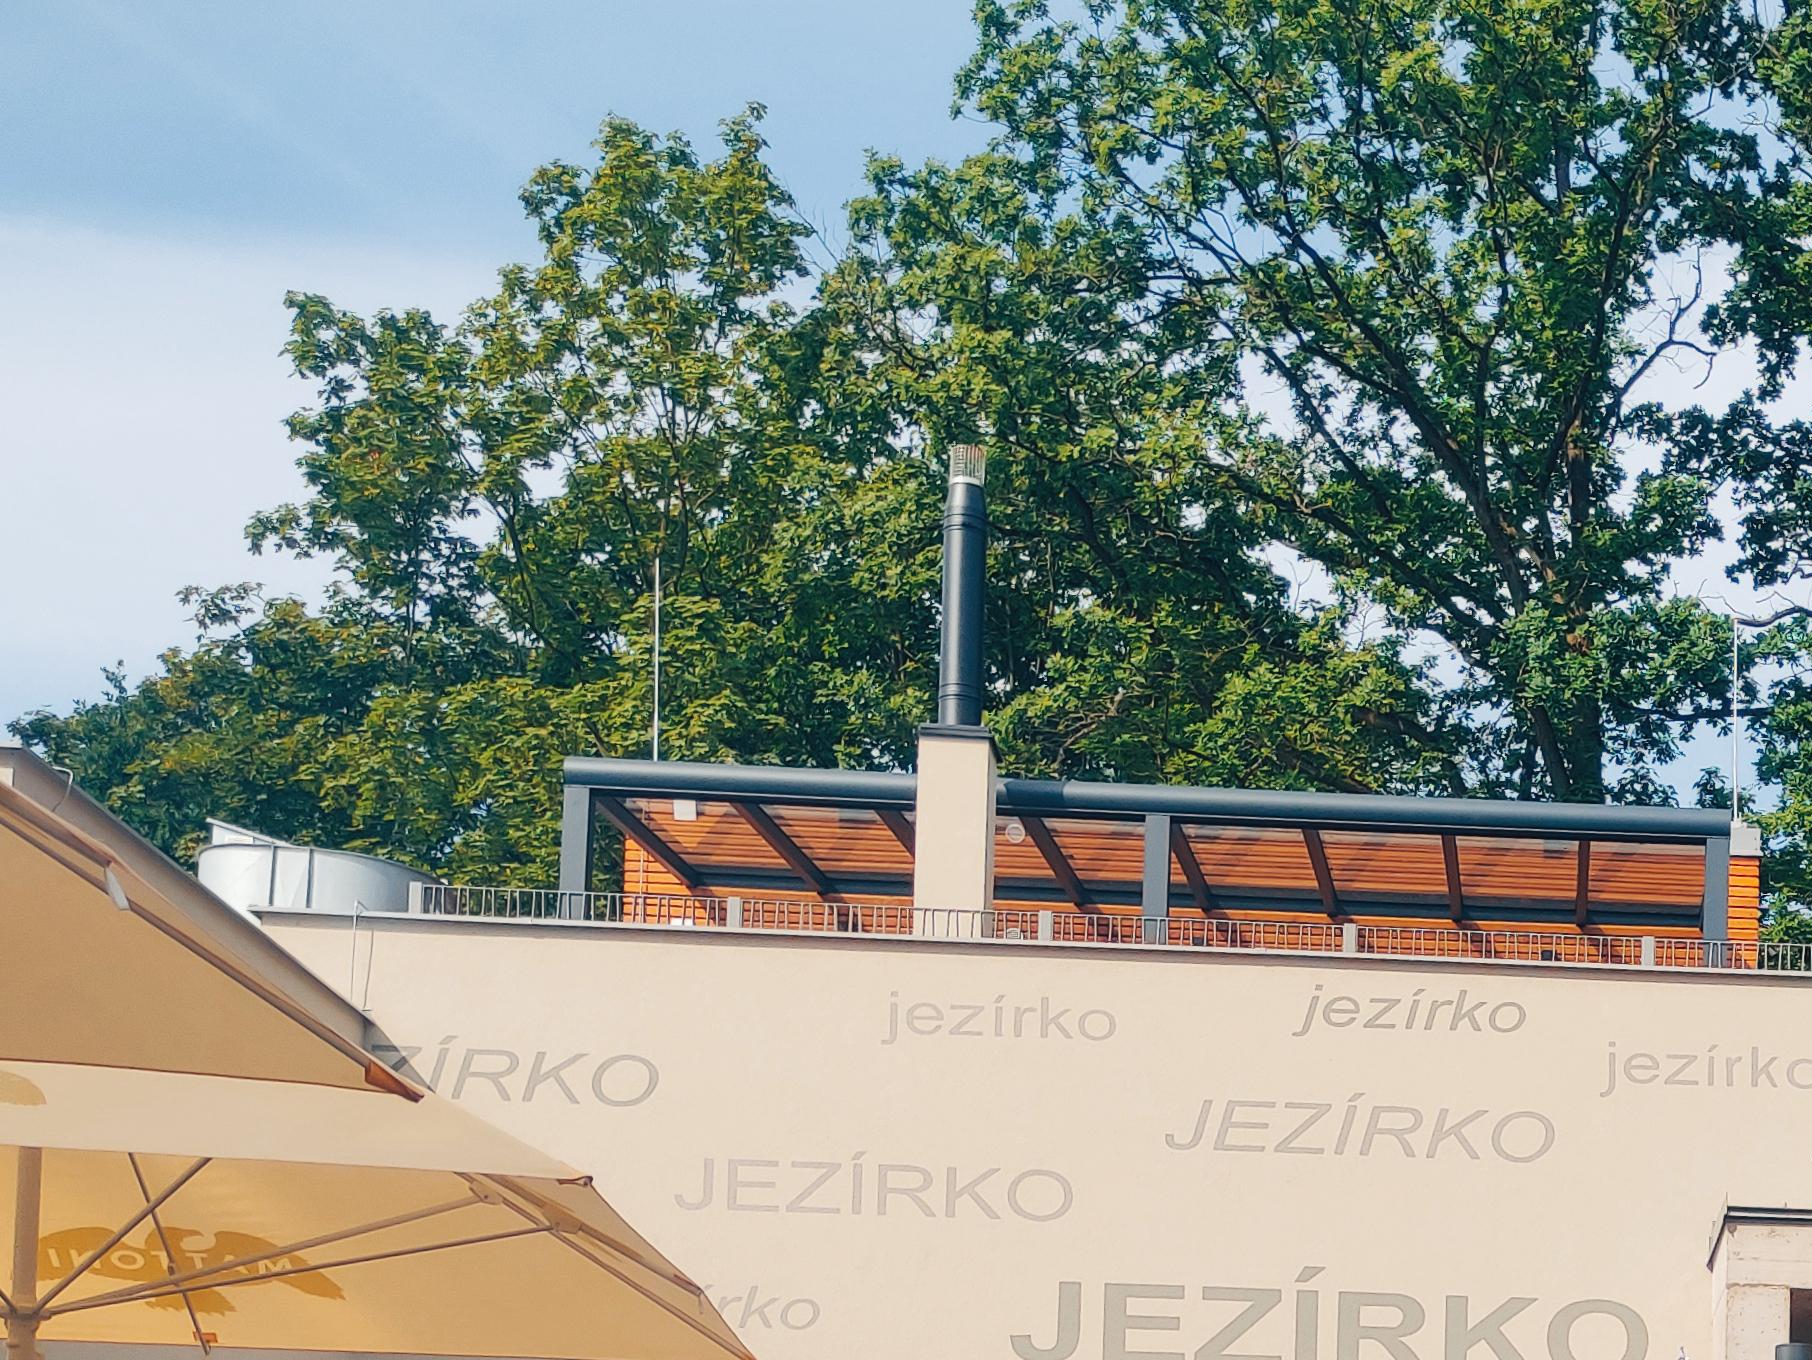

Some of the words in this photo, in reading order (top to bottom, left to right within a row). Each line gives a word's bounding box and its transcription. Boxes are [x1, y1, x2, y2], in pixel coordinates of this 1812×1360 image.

[881, 991, 1118, 1045] jezírko
[1292, 985, 1528, 1037] jezírko
[1164, 1092, 1556, 1164] JEZÍRKO
[674, 1151, 1075, 1223] JEZÍRKO
